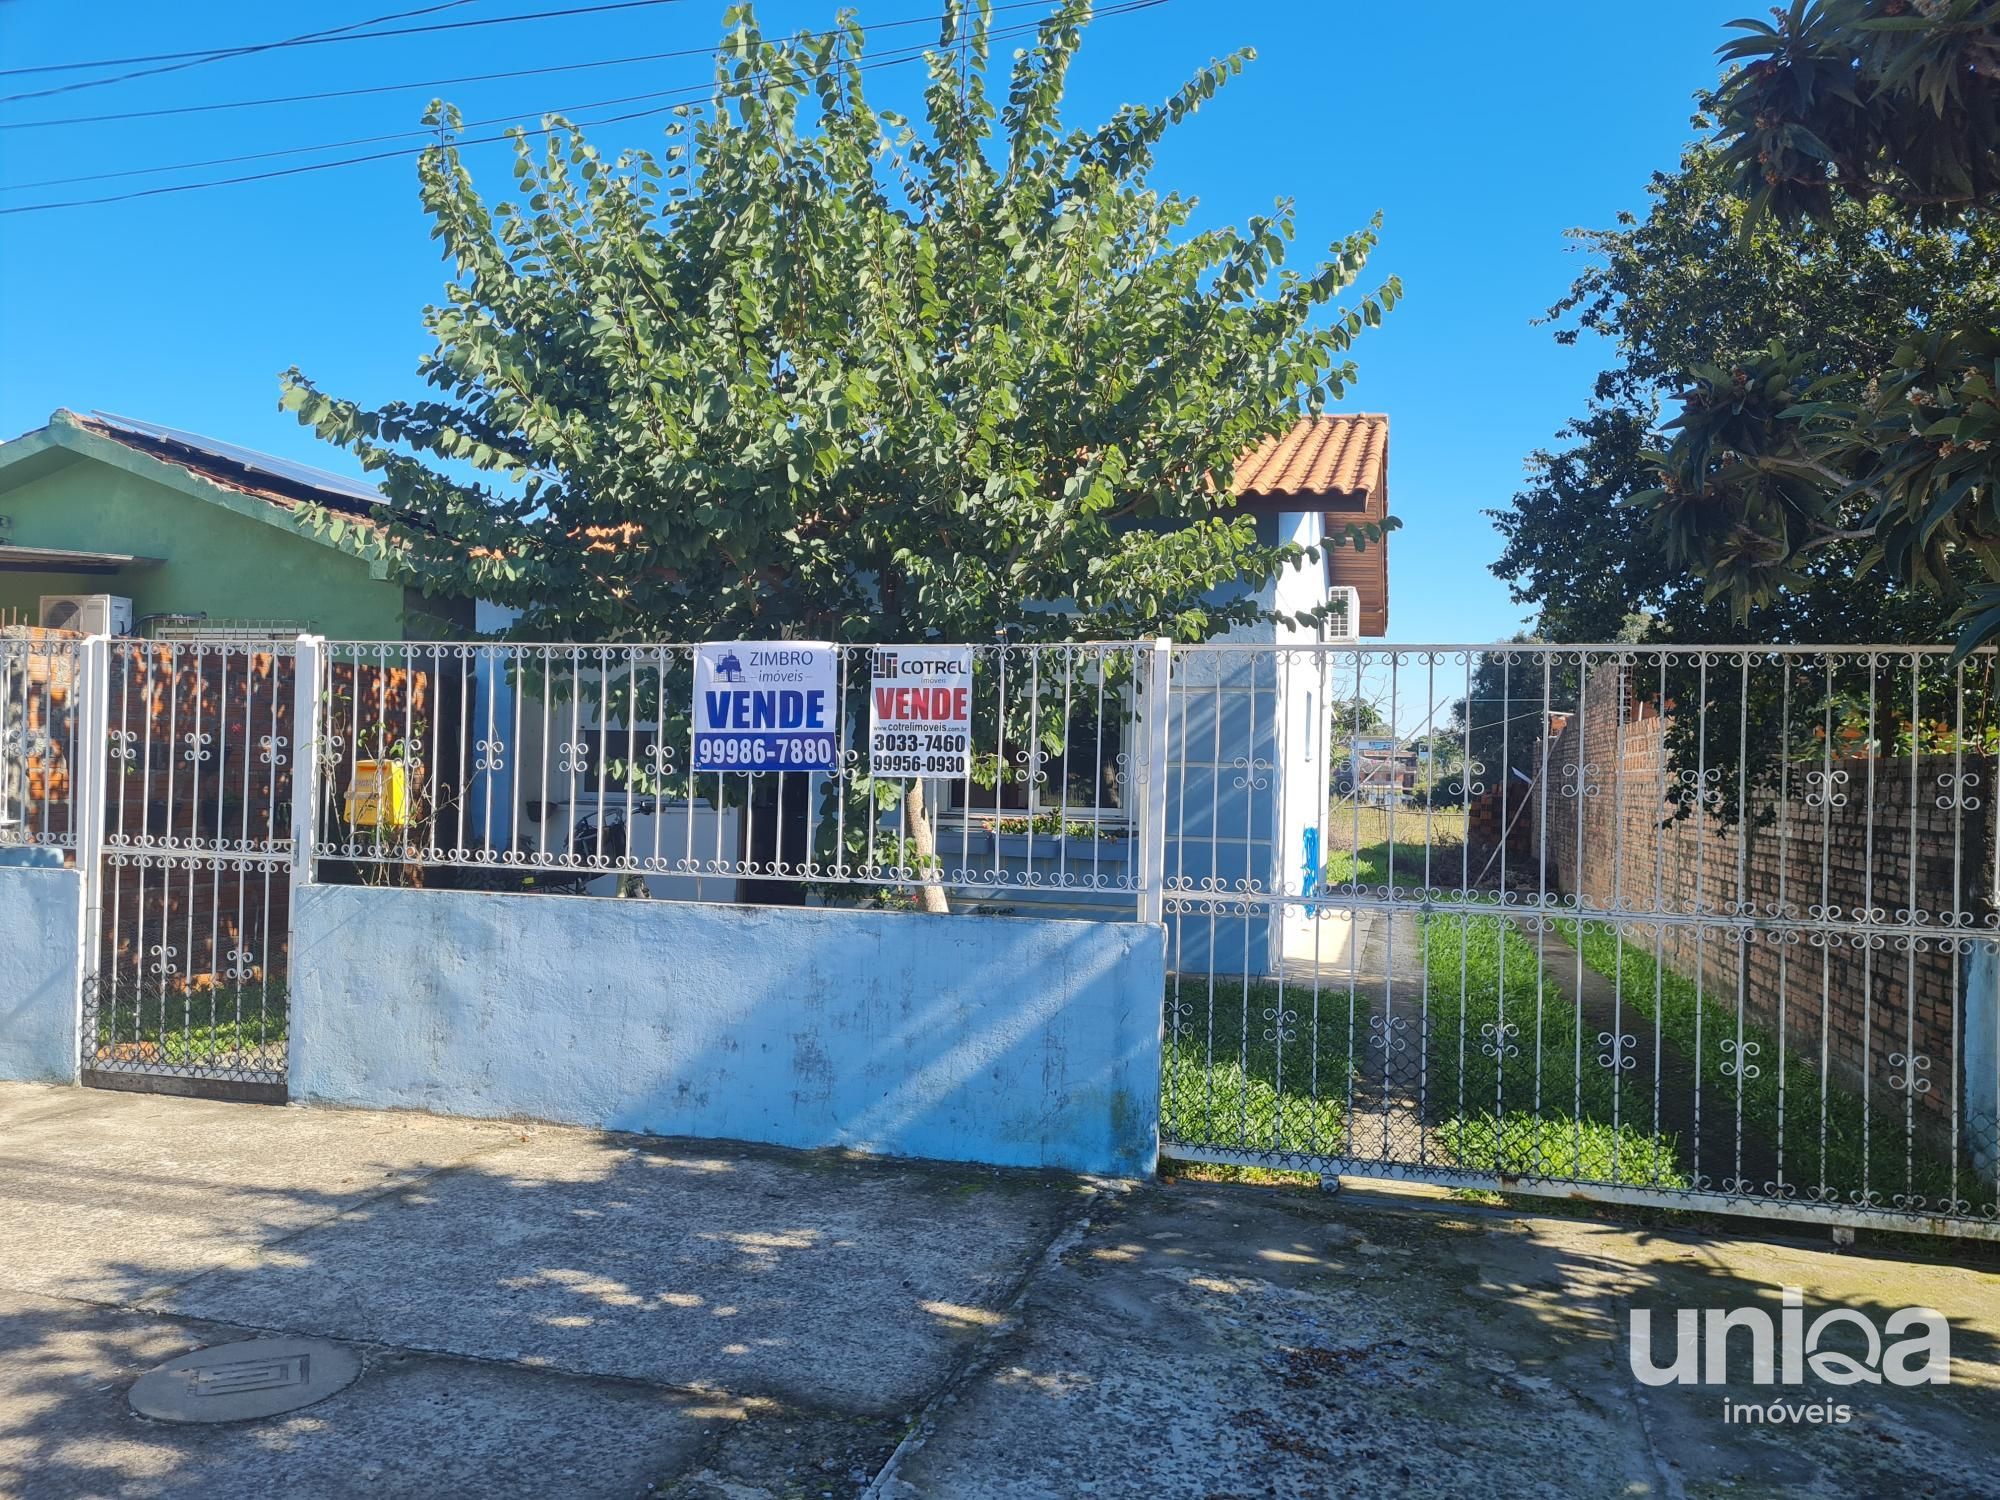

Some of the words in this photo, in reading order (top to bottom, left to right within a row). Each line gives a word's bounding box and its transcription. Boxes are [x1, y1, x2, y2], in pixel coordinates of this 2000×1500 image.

[750, 651, 814, 666] ZIMBRO
[901, 660, 967, 674] COTREL
[758, 670, 804, 682] imóveis
[705, 690, 825, 729] VENDE
[875, 687, 968, 720] VENDE
[874, 722, 967, 733] www.cotrelimoveis.com.br
[699, 738, 832, 764] 99986-7880
[874, 734, 966, 752] 3033-7460
[873, 755, 965, 773] 99956-0930
